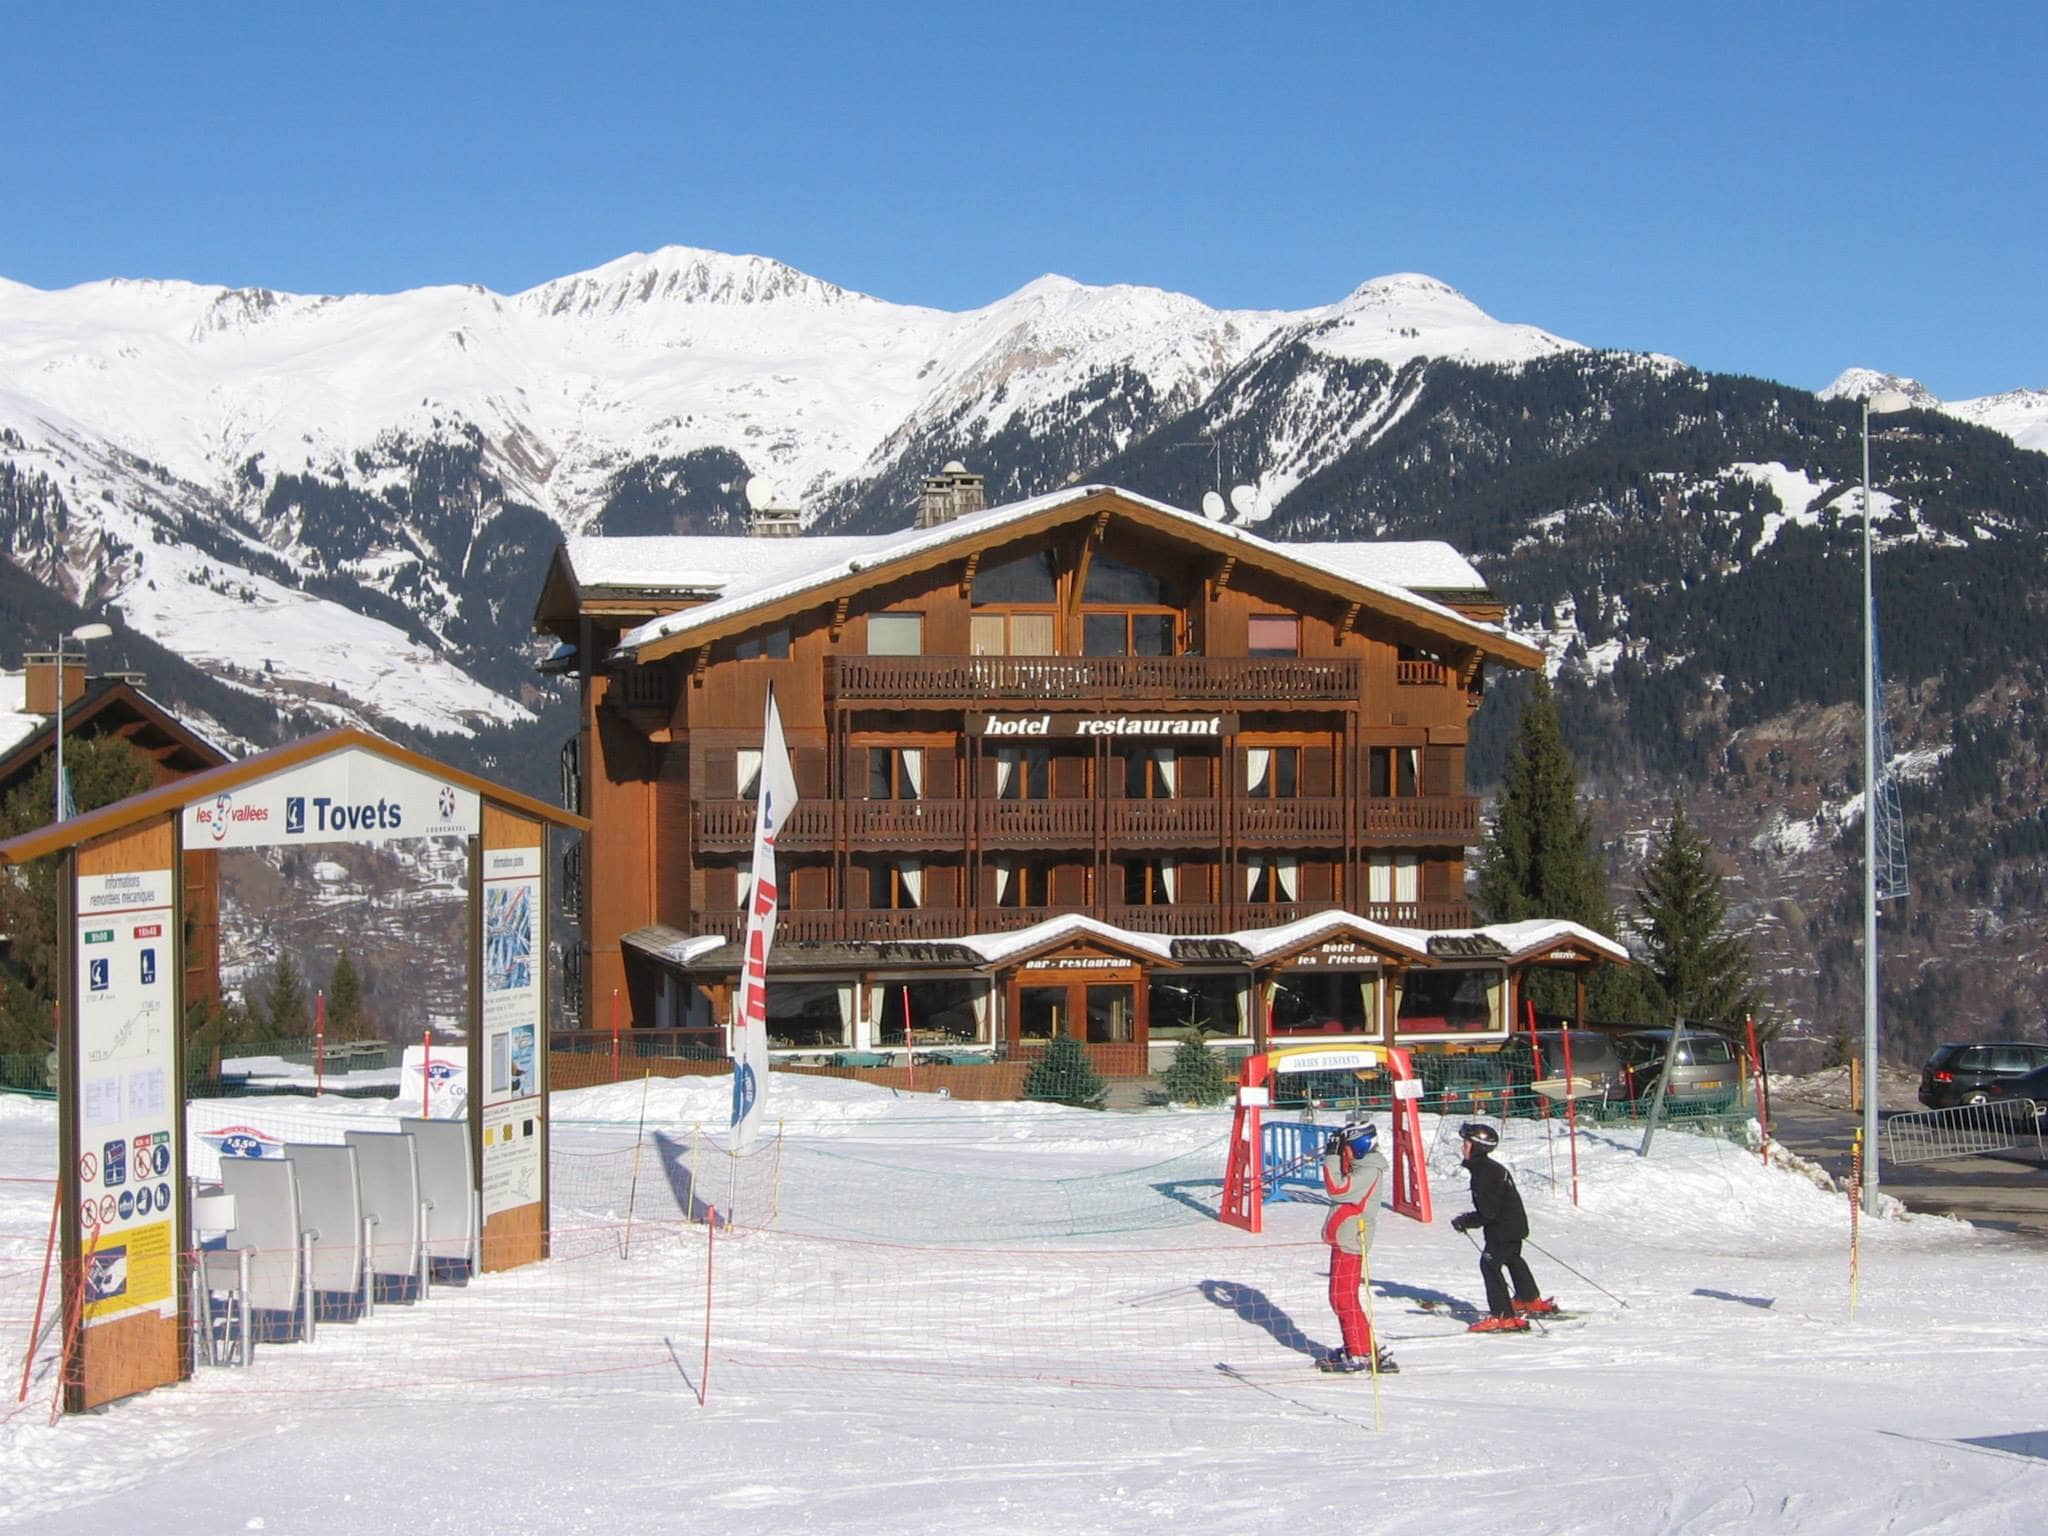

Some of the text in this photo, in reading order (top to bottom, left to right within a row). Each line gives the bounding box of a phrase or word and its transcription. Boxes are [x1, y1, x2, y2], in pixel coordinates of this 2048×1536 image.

[984, 715, 1221, 735] hotel restaurant
[195, 806, 212, 824] les
[231, 804, 269, 822] vallées
[312, 797, 402, 831] Tovets
[1321, 943, 1355, 953] hotel
[227, 1137, 258, 1148] 1550
